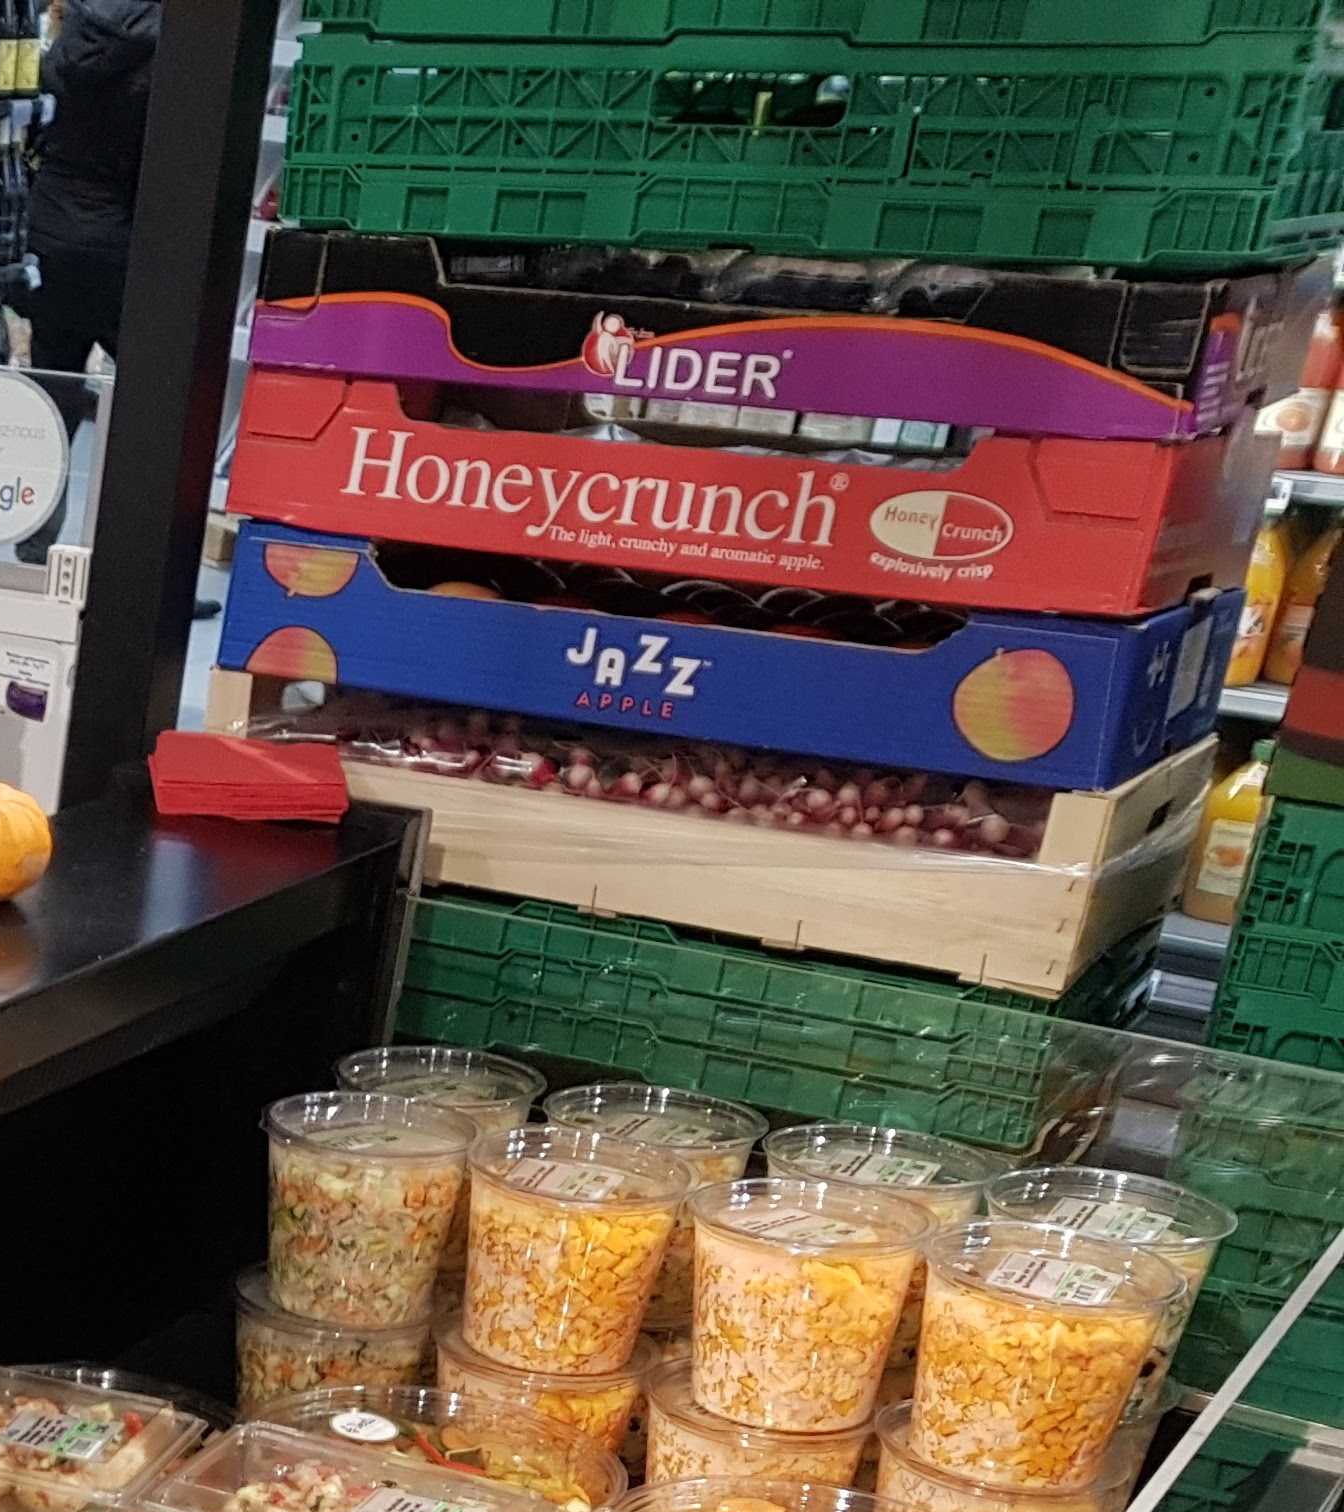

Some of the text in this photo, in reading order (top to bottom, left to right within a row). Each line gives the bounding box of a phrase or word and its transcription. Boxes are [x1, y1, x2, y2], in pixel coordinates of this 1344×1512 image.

[614, 344, 782, 399] LIDER
[884, 506, 939, 530] Honey
[941, 522, 1003, 543] Crunch
[549, 525, 825, 571] The light, crunchy and aromatic apple.
[870, 552, 994, 582] explosively crisp
[567, 627, 703, 696] JAZZ
[575, 692, 674, 718] APPLE
